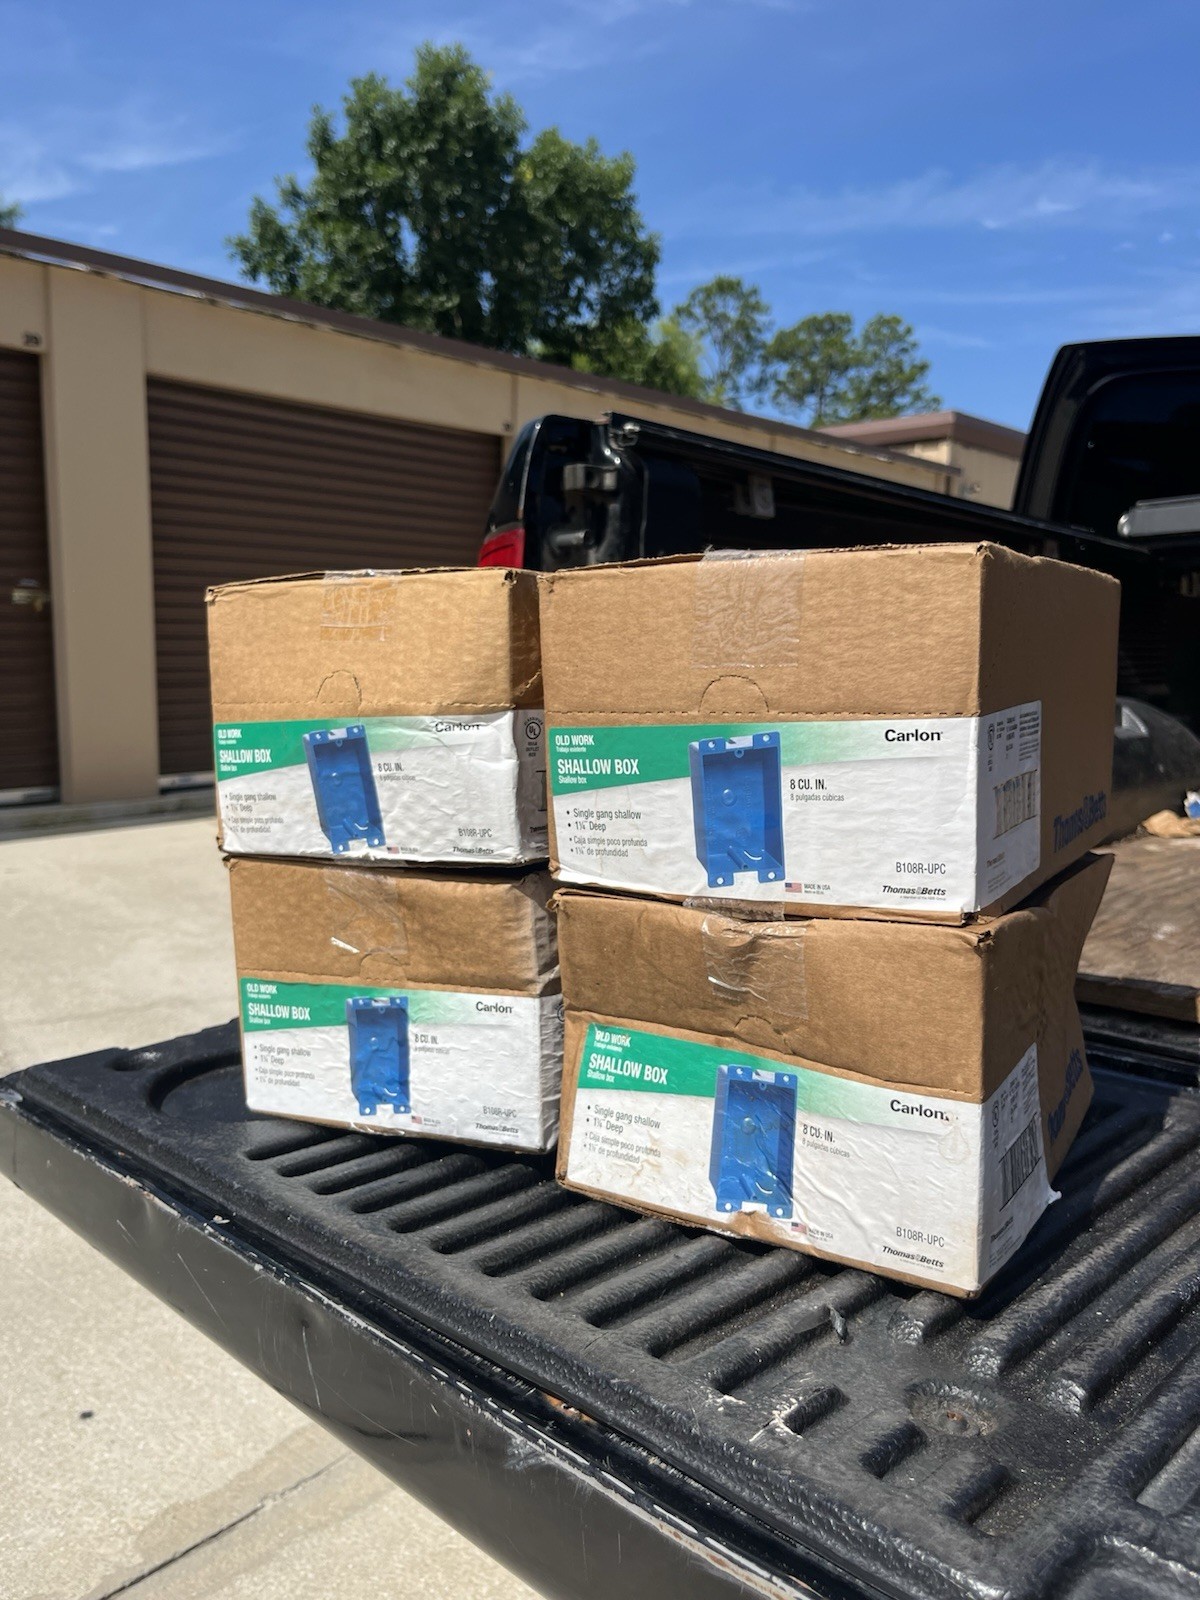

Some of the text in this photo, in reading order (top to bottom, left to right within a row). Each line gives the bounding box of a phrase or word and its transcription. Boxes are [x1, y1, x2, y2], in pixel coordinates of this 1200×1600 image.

[218, 728, 242, 738] OLD WORK
[885, 729, 941, 742] Carlon
[555, 735, 594, 745] OLD WORK
[220, 749, 272, 763] SHALLOW BOX
[383, 763, 394, 772] CU.
[558, 759, 640, 774] SHALLOW BOX
[558, 775, 587, 784] Shallow box
[790, 779, 827, 790] 8 CU. IN.
[796, 793, 821, 803] pulgadas
[822, 793, 844, 801] cúbicas
[573, 808, 641, 820] Single gang shallow
[458, 828, 492, 837] B108R-UPC
[589, 821, 606, 832] Deep
[574, 836, 586, 846] Caja
[587, 837, 605, 846] simple
[622, 838, 648, 847] profunda
[587, 847, 594, 856] de
[595, 847, 628, 857] profundidad
[896, 862, 946, 874] B108R-UPC
[246, 983, 278, 994] OLD WORK
[248, 1002, 311, 1020] SHALLOW BOX
[476, 1001, 512, 1014] Carlon
[611, 1034, 631, 1048] WORK
[589, 1053, 668, 1085] SHALLOW BOX
[594, 1105, 661, 1129] Single gang shallow
[606, 1121, 623, 1134] Deep
[803, 1124, 808, 1134] 8
[825, 1129, 835, 1143] IN.
[601, 1136, 620, 1147] simple
[621, 1141, 634, 1150] poco
[807, 1140, 829, 1152] pulgadas
[606, 1149, 640, 1164] profundidad
[896, 1227, 945, 1248] B108R-UPC
